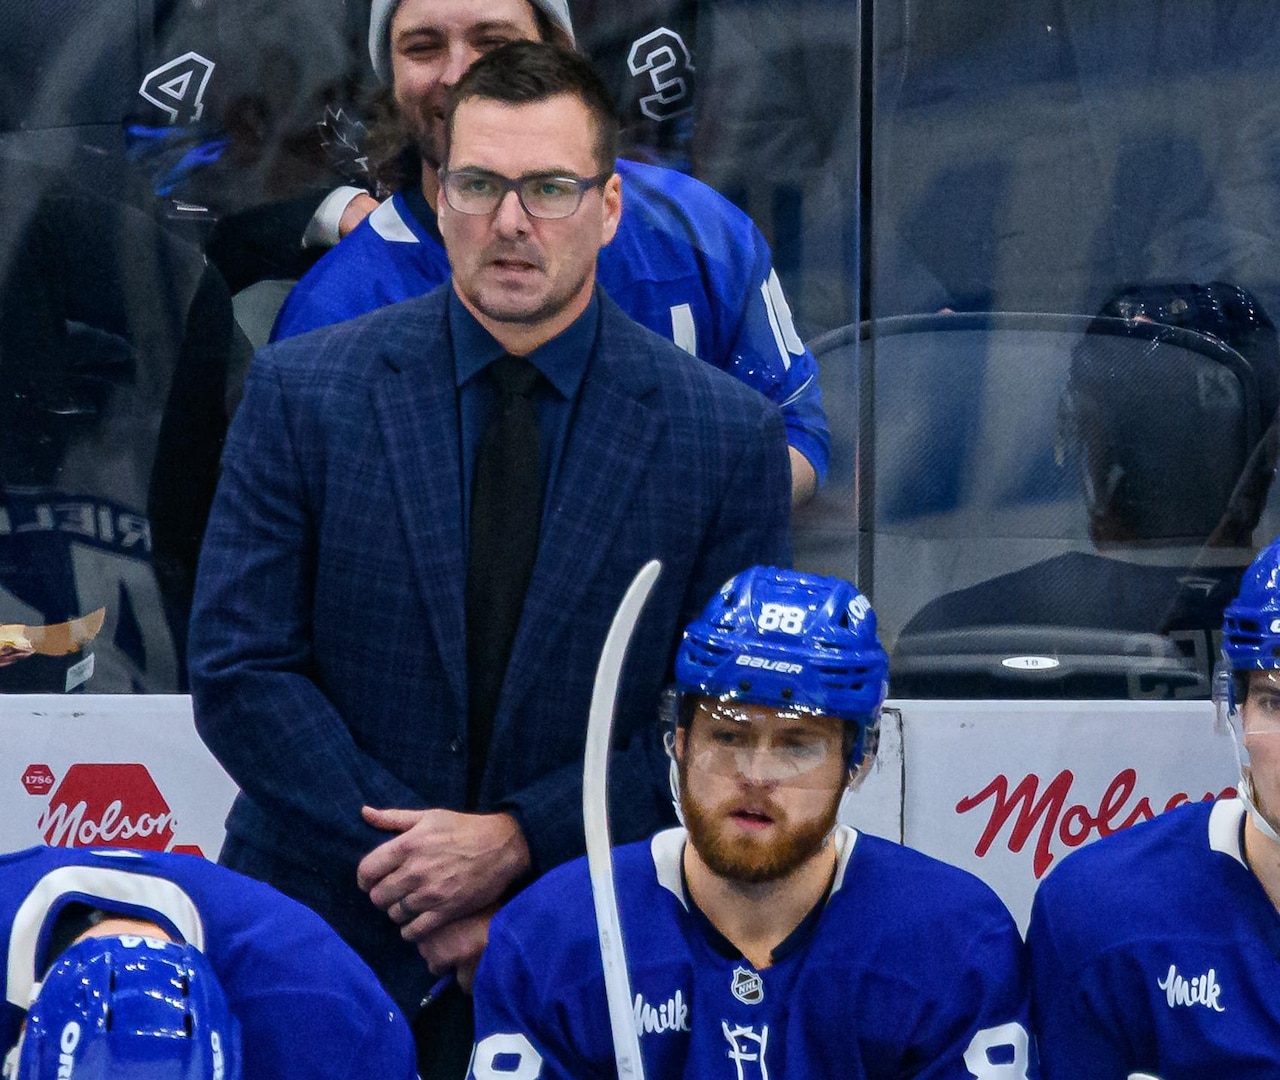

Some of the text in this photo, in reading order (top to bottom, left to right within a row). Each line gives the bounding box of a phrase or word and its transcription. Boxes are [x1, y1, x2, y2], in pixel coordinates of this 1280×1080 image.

[757, 603, 806, 635] 88
[735, 655, 803, 675] BAUER
[25, 776, 53, 785] 1786
[37, 800, 178, 848] Molson
[1158, 965, 1225, 1012] Milk
[632, 990, 691, 1037] Milk
